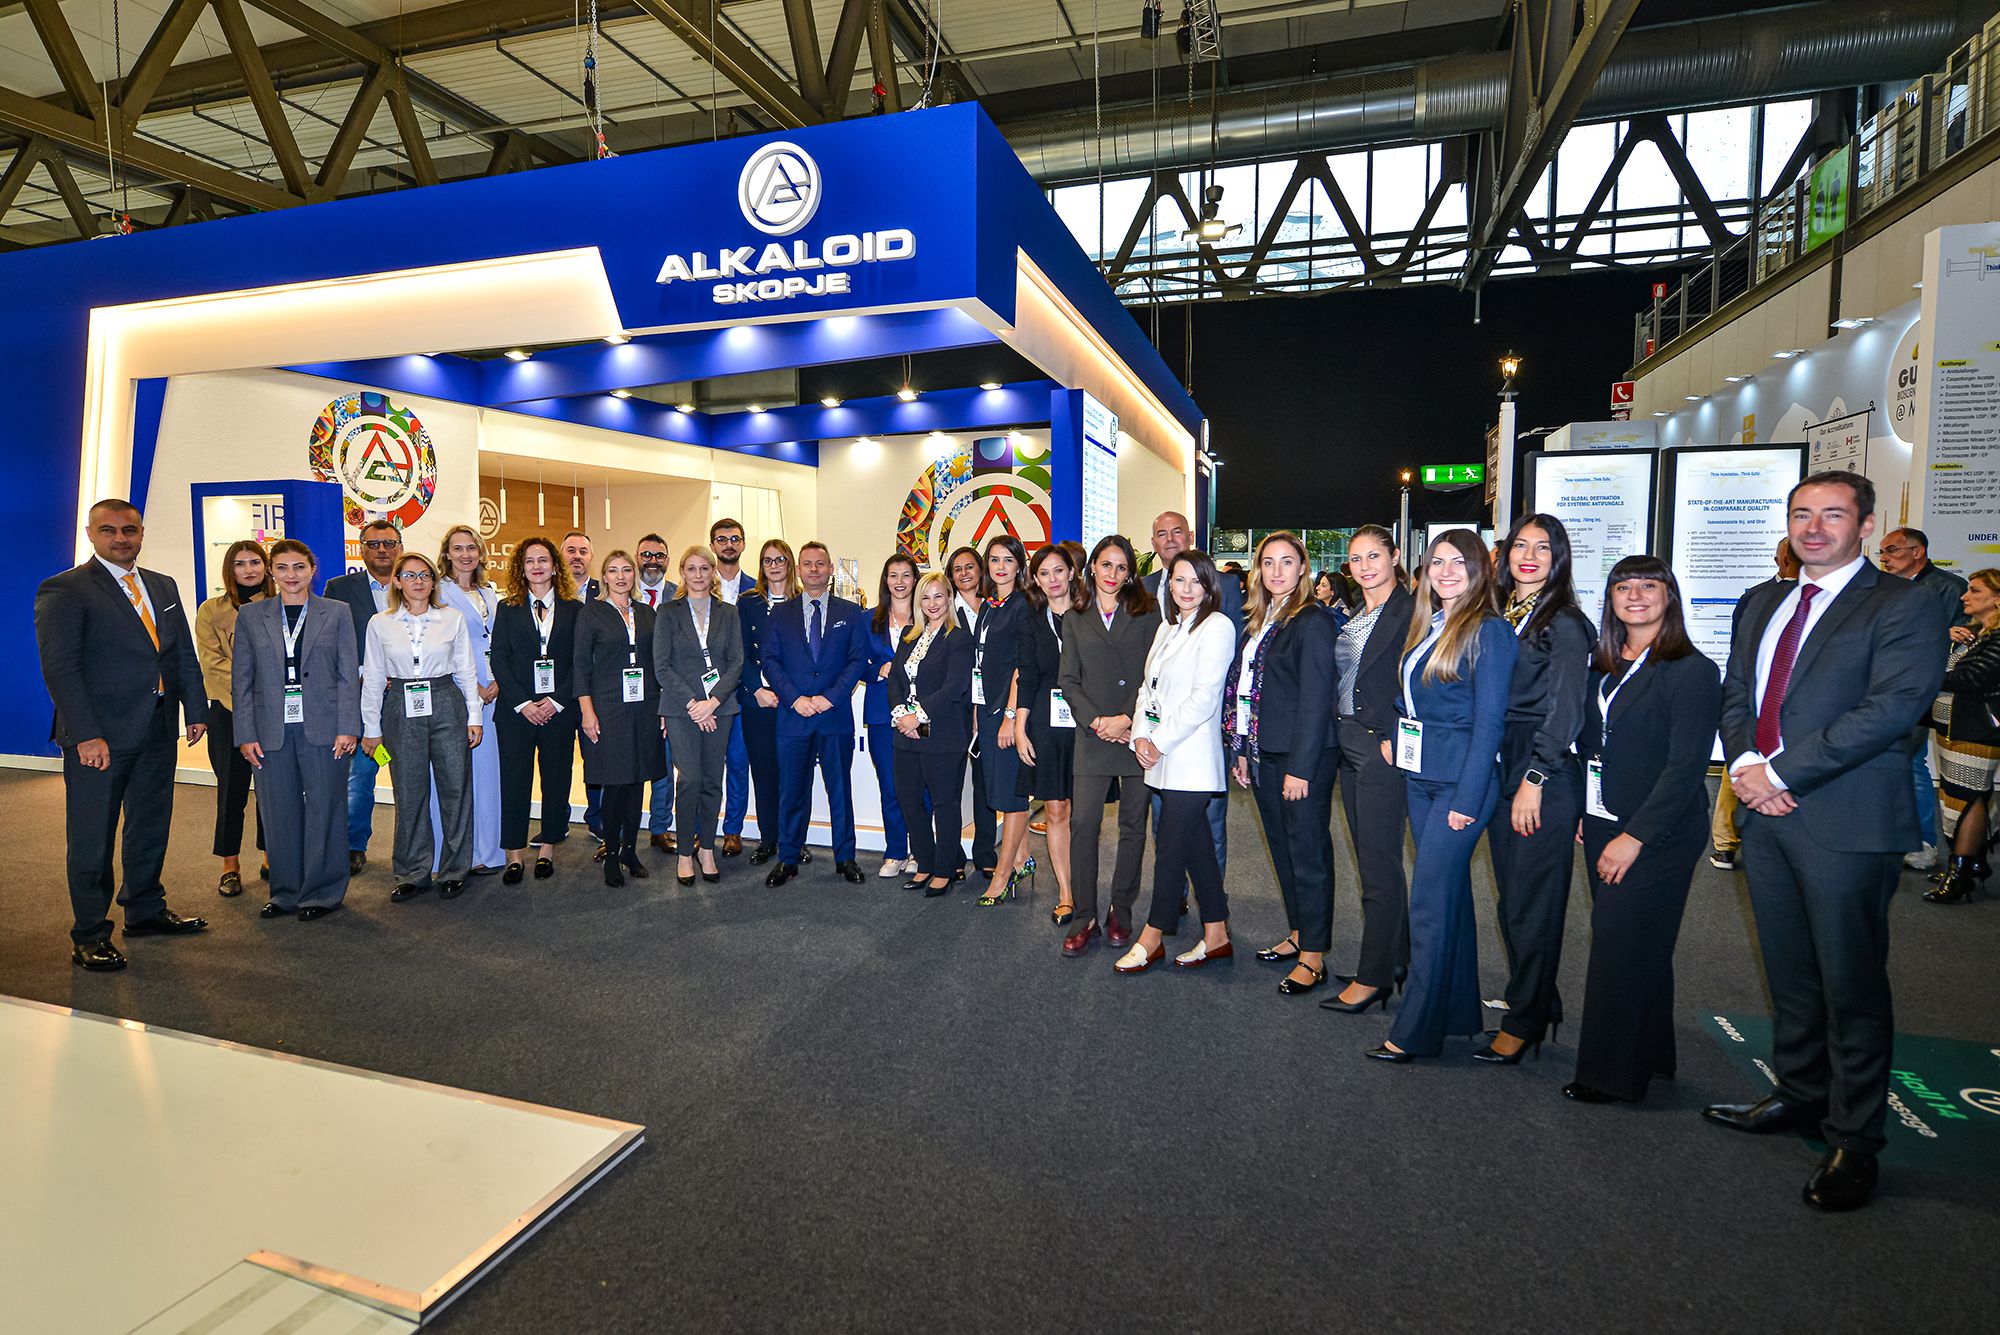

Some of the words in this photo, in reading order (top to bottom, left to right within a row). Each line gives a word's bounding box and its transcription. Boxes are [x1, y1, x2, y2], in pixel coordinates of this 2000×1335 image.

[655, 228, 916, 284] ALKALOID
[712, 272, 851, 304] SKOPJE
[1888, 1069, 1948, 1101] Hall
[1926, 1101, 1969, 1120] 14
